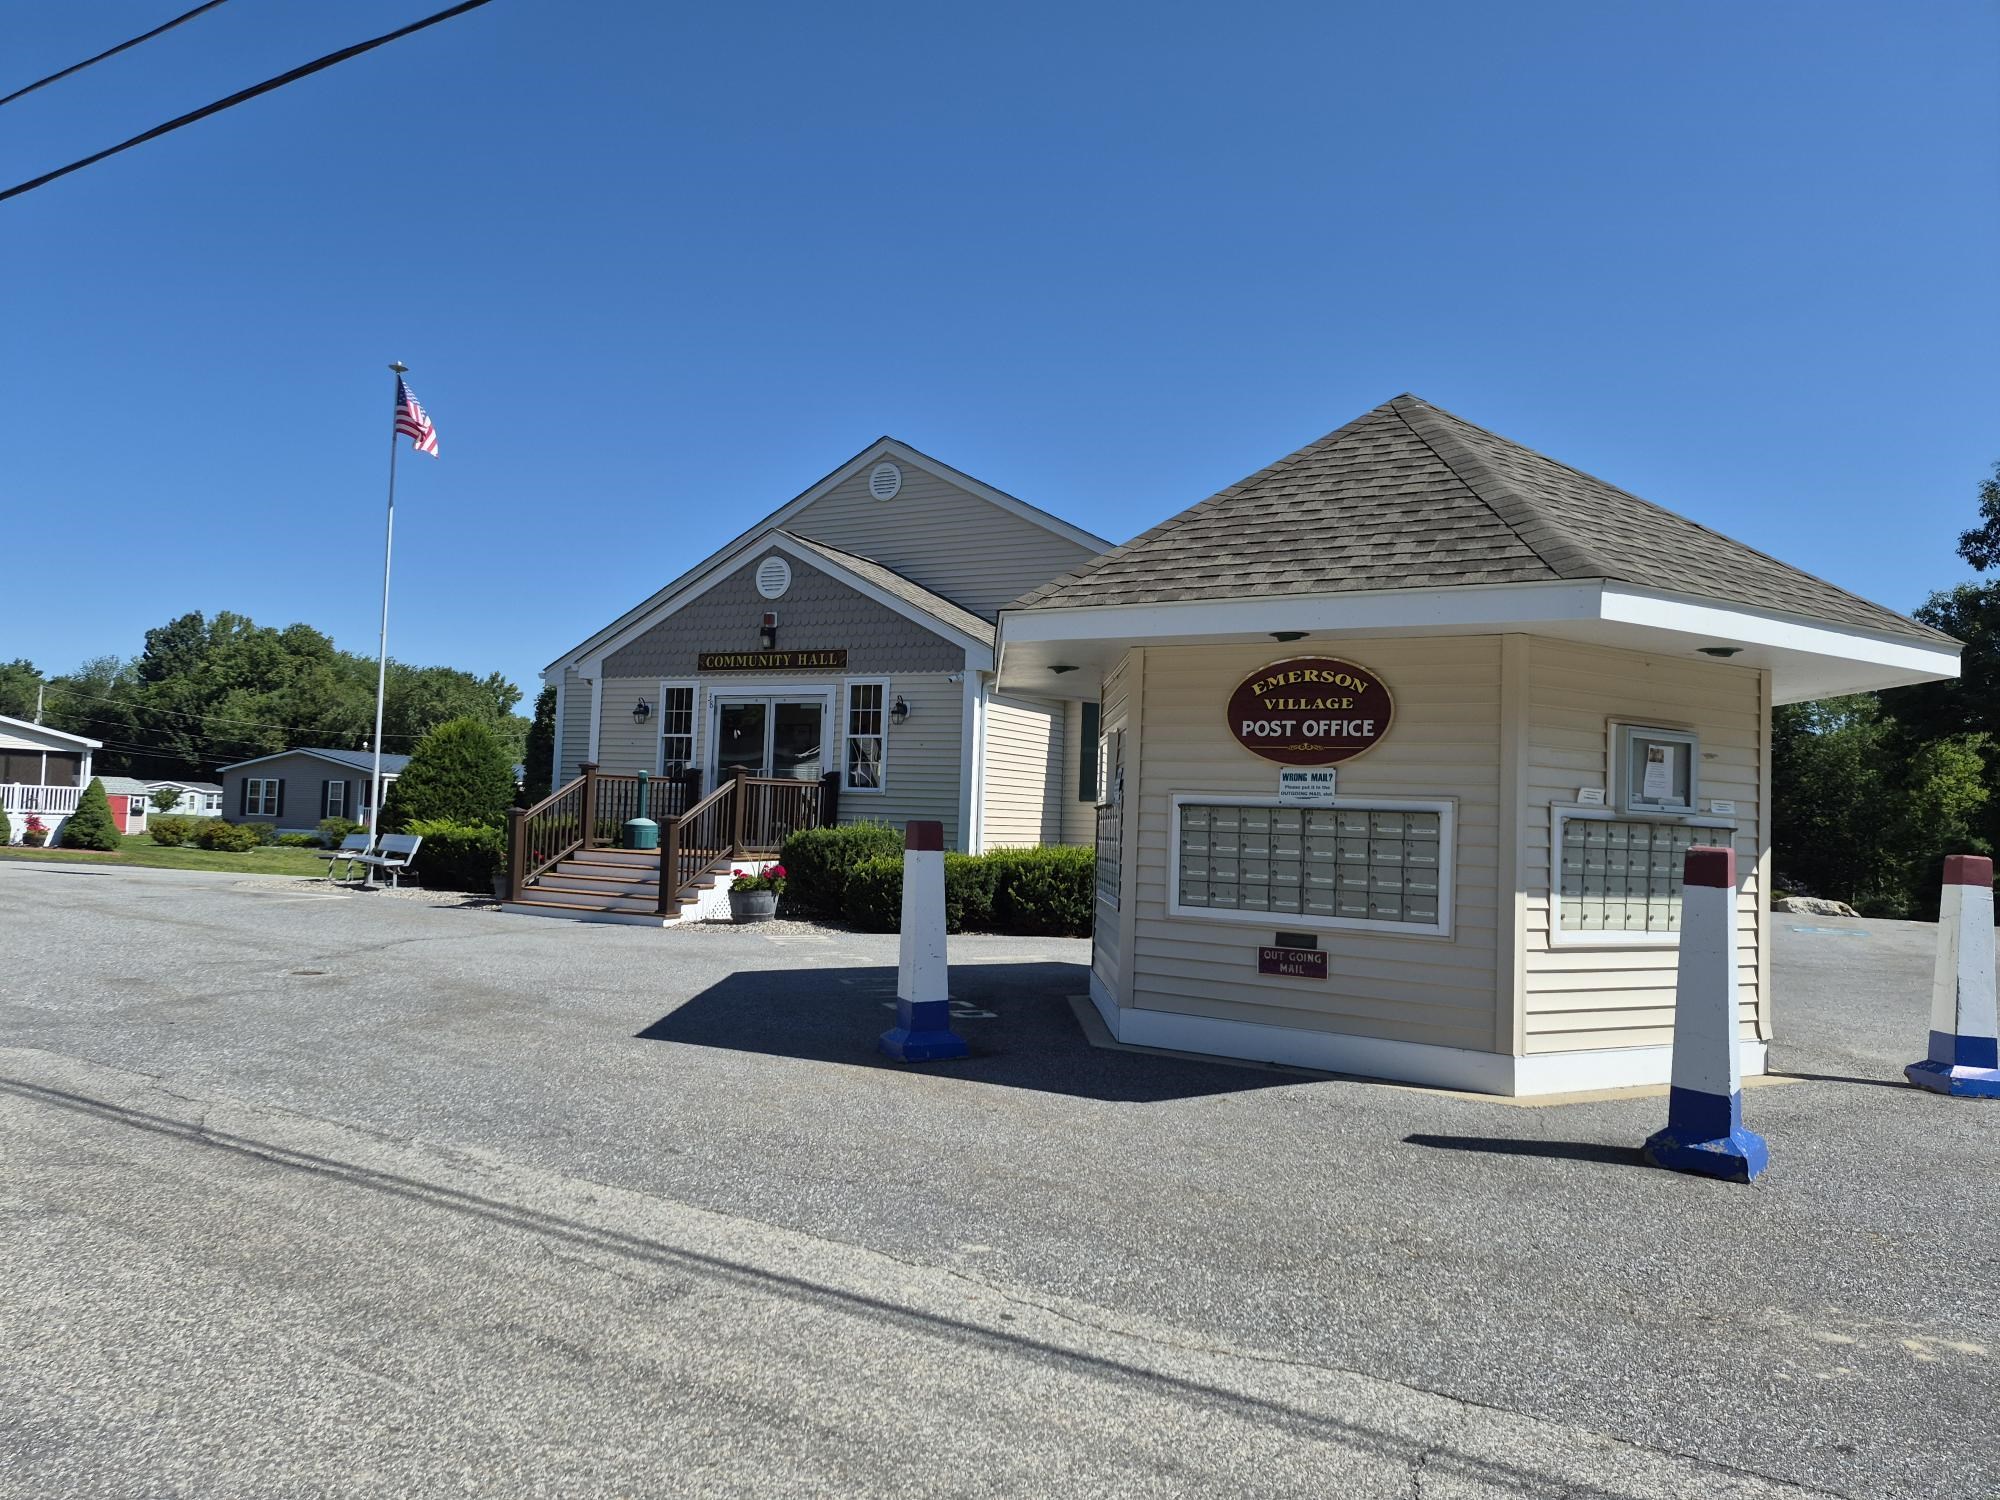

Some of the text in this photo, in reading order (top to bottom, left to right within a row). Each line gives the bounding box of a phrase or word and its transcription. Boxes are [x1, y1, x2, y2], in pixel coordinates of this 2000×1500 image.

[706, 653, 837, 668] COMMUNITY HALL
[1251, 669, 1369, 696] EMERSON
[1264, 698, 1354, 711] VILLAGE
[1242, 719, 1375, 737] POST OFFICE
[1282, 772, 1334, 782] WRONG MAIL?
[1263, 950, 1321, 964] OUT GOING
[1280, 963, 1305, 974] MAIL
